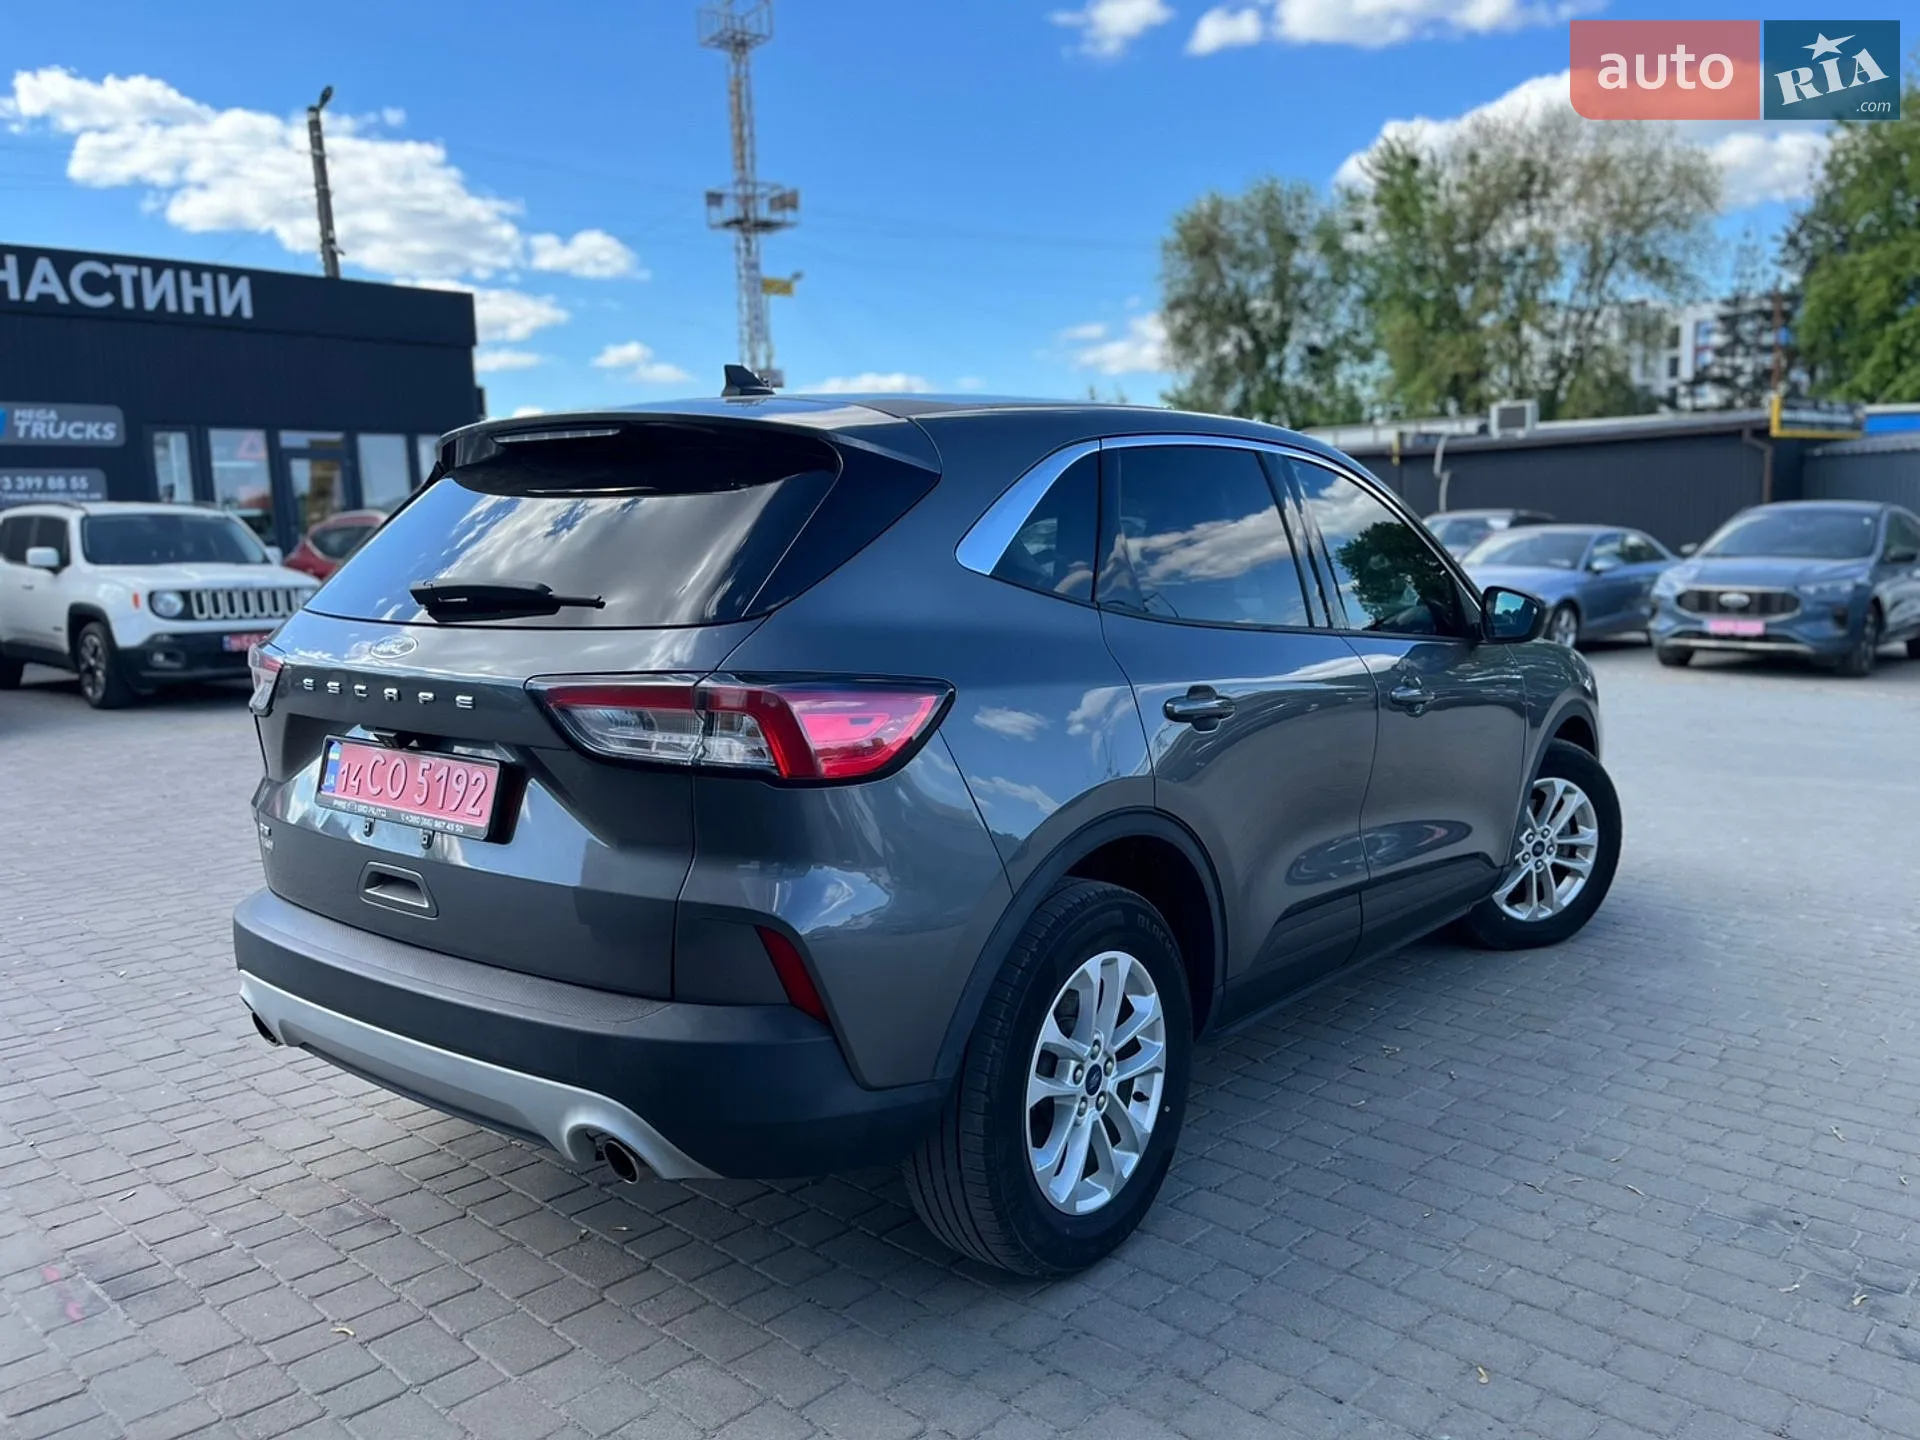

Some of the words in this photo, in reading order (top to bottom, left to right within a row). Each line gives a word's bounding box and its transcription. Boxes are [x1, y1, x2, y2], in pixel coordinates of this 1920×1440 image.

[13, 408, 59, 420] MEGA
[14, 420, 117, 440] TRUCKS
[303, 677, 474, 709] ESCAPE
[413, 760, 488, 817] 5192
